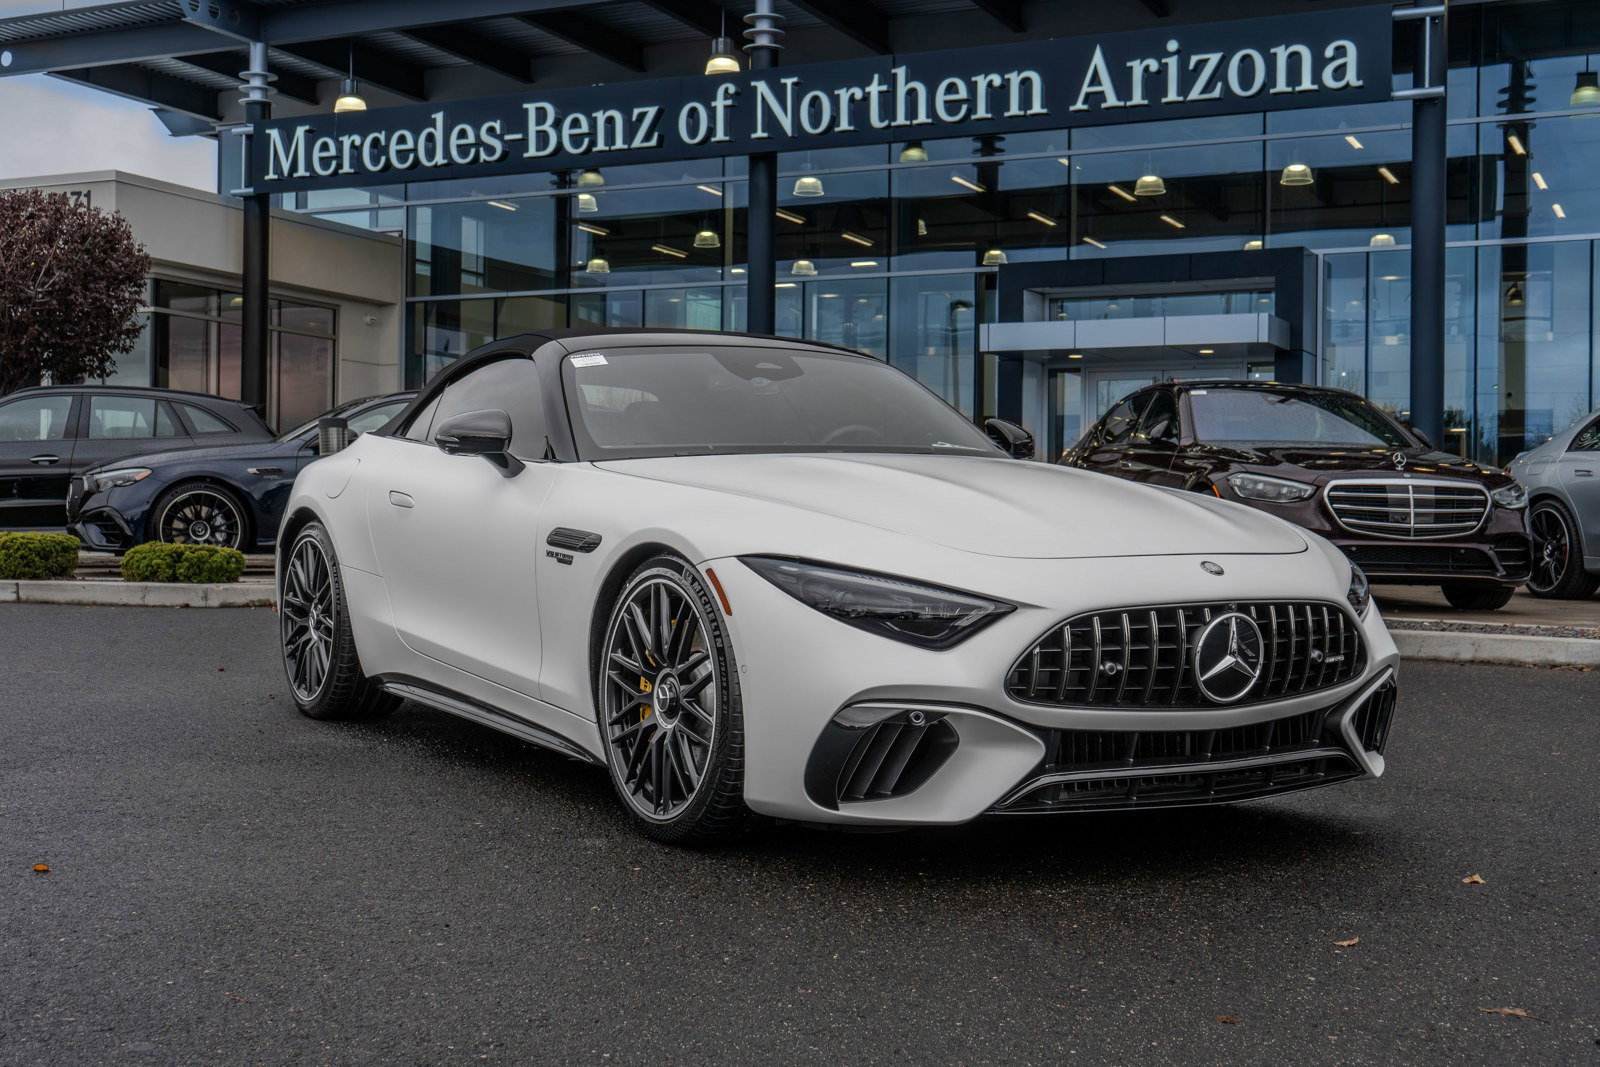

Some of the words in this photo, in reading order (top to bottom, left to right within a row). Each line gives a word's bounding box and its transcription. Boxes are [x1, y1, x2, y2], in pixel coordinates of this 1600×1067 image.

[264, 101, 660, 180] Mercedes-Benz
[678, 83, 736, 145] of
[751, 65, 1049, 139] Northern
[1069, 39, 1364, 111] Arizona
[692, 582, 723, 648] MICHELIN
